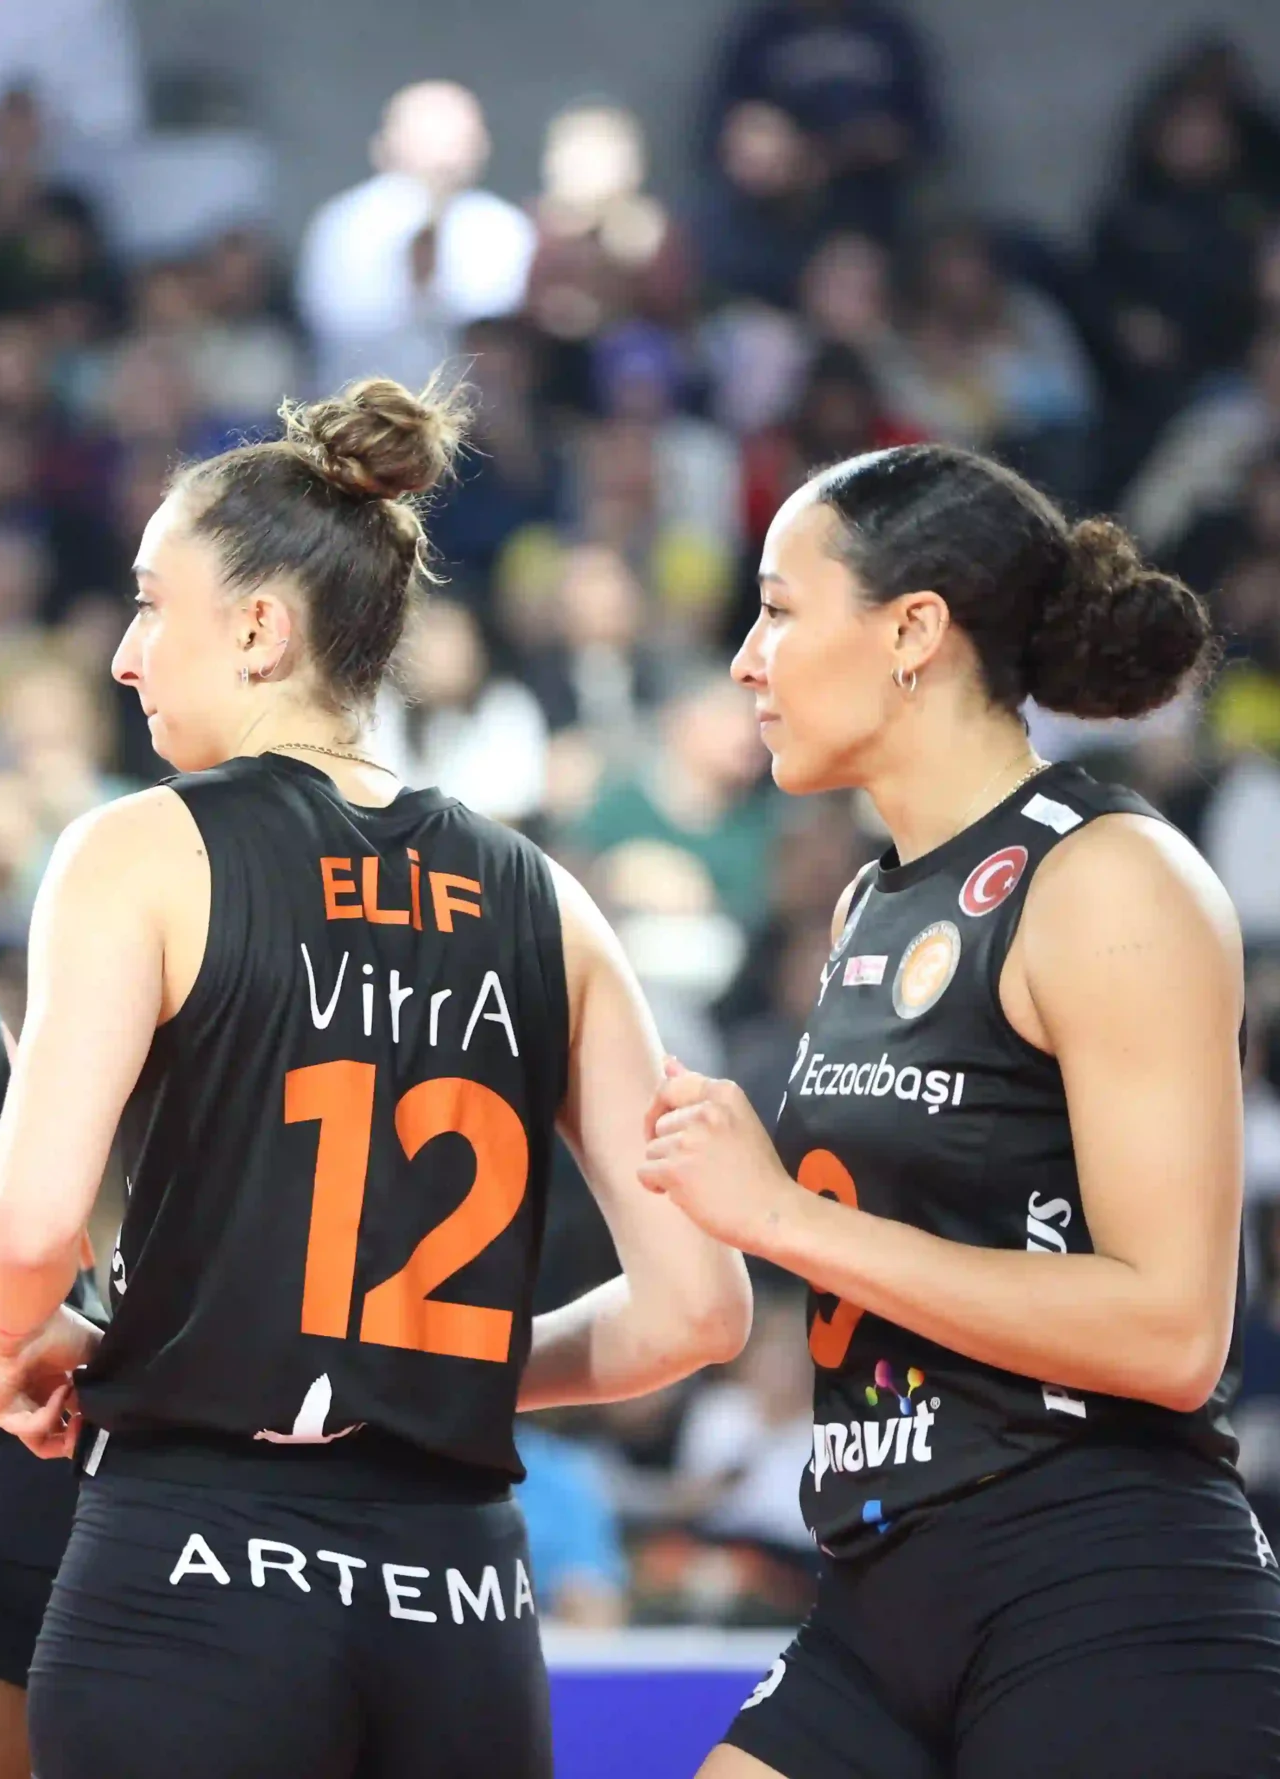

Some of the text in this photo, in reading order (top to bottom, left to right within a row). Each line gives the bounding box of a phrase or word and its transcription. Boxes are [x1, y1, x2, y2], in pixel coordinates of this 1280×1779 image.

[320, 847, 482, 933] ELİF
[300, 942, 519, 1058] VitrA
[284, 1059, 529, 1363] 12
[169, 1533, 535, 1625] ARTEMA
